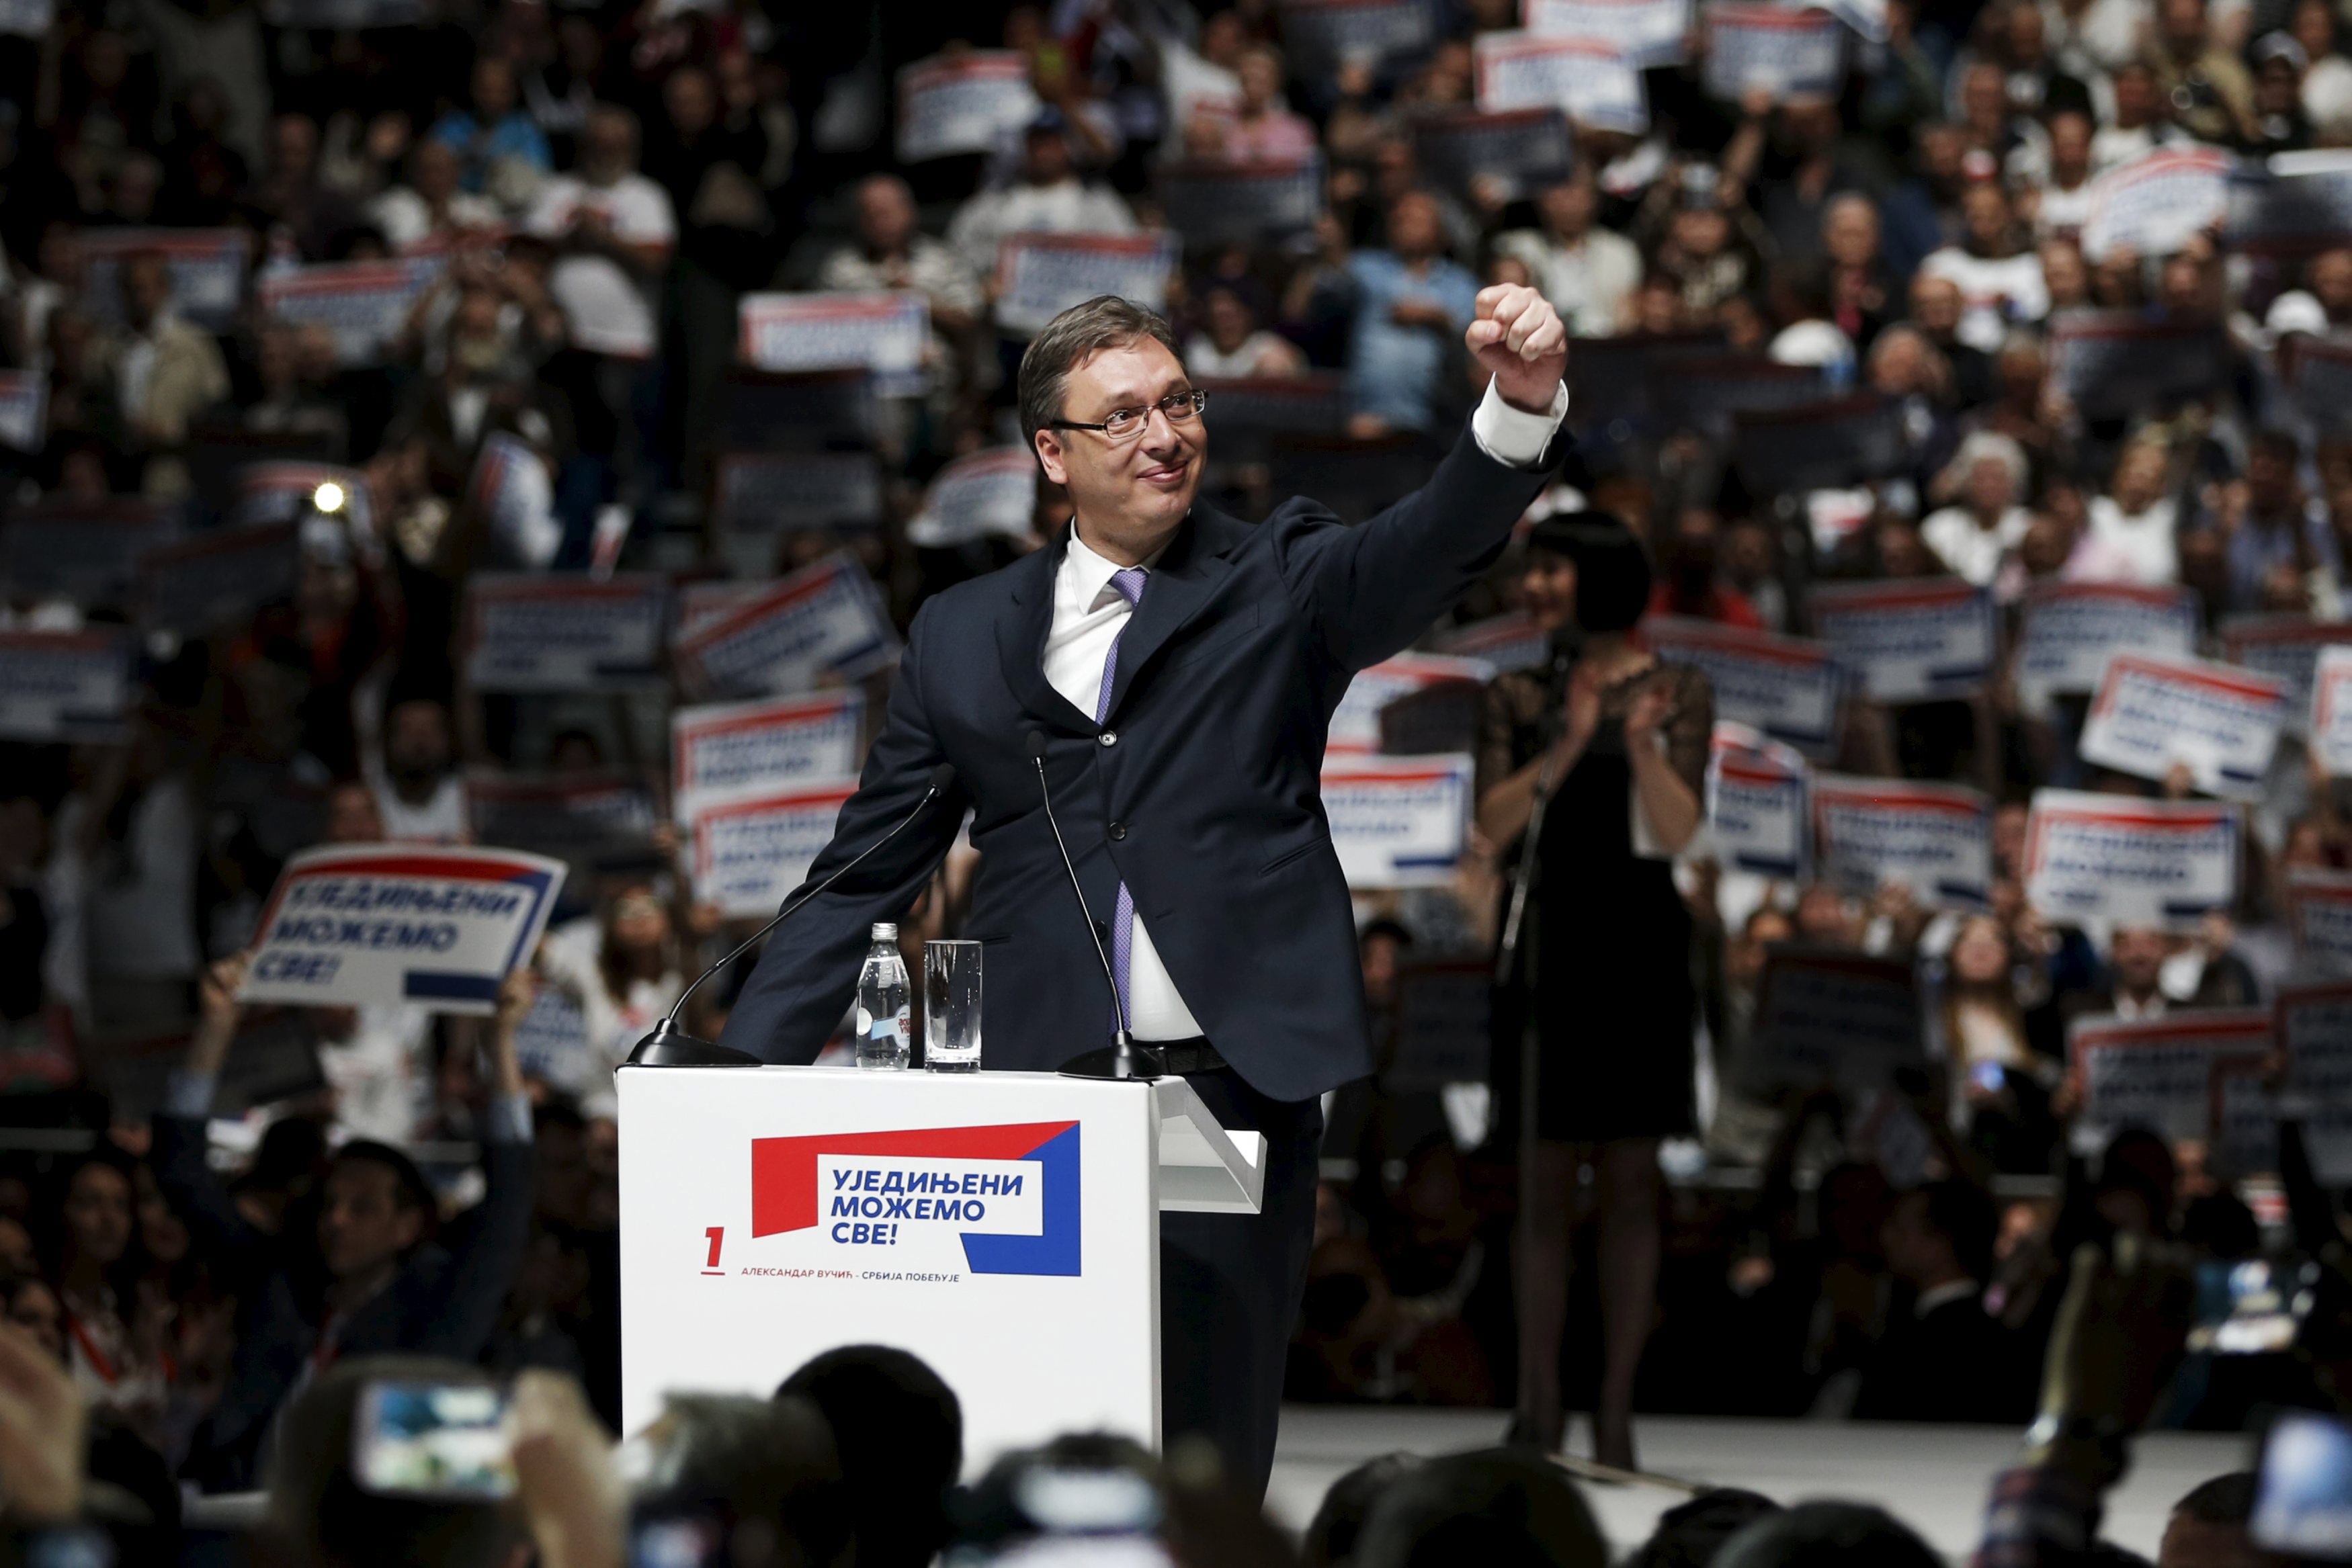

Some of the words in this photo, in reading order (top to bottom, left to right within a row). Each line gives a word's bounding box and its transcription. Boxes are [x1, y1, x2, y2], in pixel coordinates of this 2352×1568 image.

[272, 914, 460, 954] МОЖЕМО
[833, 1169, 1023, 1196] УЈЕДИЊЕНИ
[831, 1196, 985, 1221] МОЖЕМО
[704, 1226, 725, 1268] 1
[831, 1222, 898, 1246] СВЕ!
[741, 1267, 814, 1278] АЛЕКСАНДАР
[816, 1269, 853, 1279] ВУЧИЋ
[862, 1271, 902, 1280] СРБИЈА
[905, 1272, 960, 1282] ПОБЕЂУЈЕ
